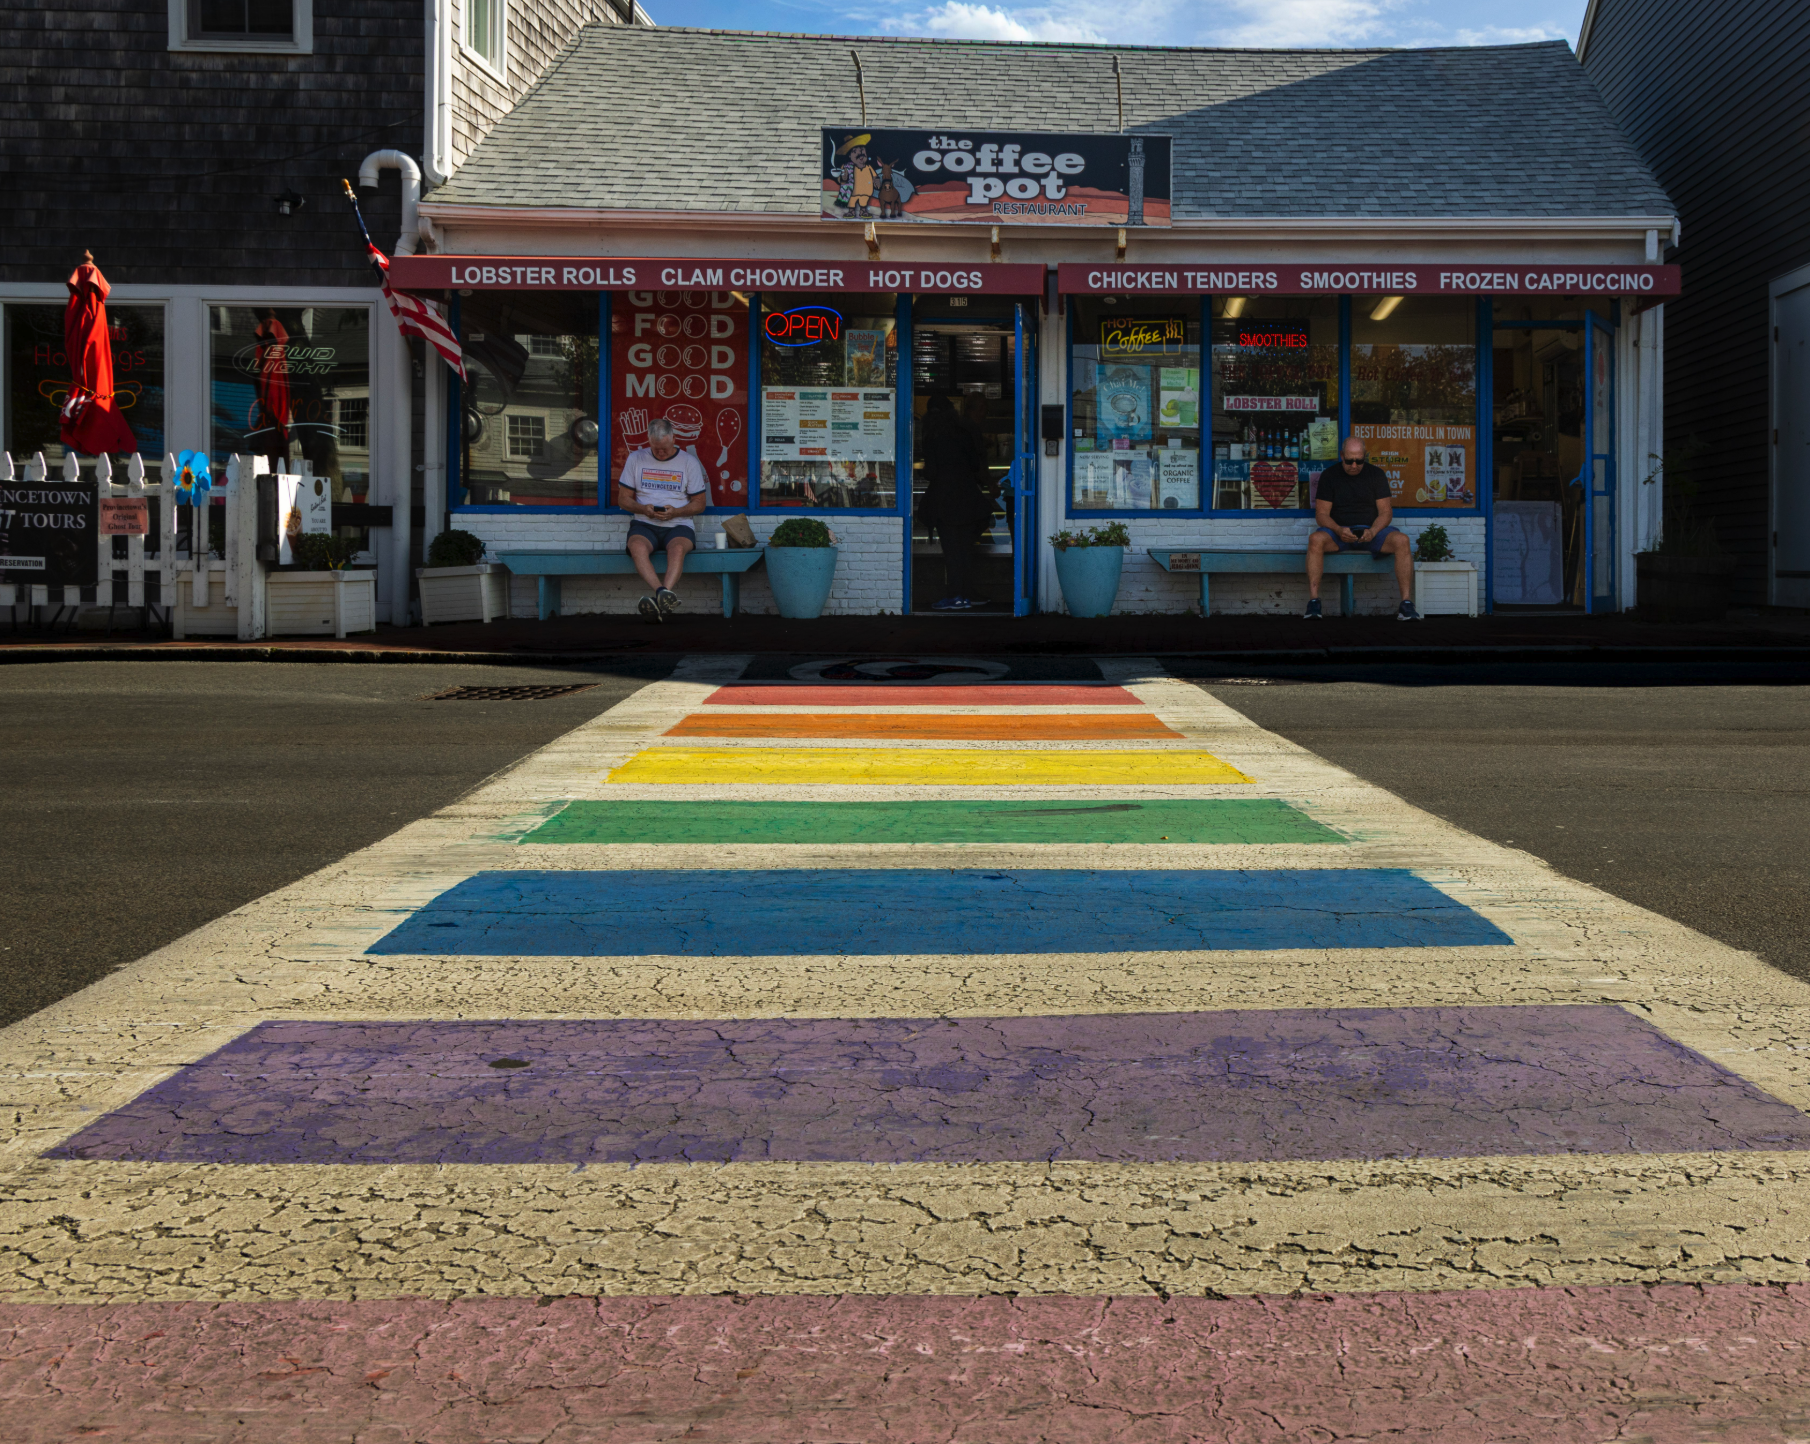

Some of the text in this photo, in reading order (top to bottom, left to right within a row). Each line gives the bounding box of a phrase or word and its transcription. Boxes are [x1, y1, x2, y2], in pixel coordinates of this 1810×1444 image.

[929, 135, 973, 150] the
[913, 143, 1085, 175] coffee
[966, 170, 1067, 204] pot
[993, 203, 1087, 217] RESTAURANT
[452, 266, 637, 285] LOBSTER ROLLS
[661, 268, 845, 287] CLAM CHOWDER
[870, 271, 984, 289] HOT DOGS
[1087, 271, 1278, 289] CHICKEN TENDERS
[1300, 272, 1417, 289] SMOOTHIES
[1439, 273, 1654, 291] FROZEN CAPPUCCINO
[628, 290, 736, 309] GOOD
[951, 298, 967, 306] 315
[634, 313, 735, 338] FOOD
[765, 312, 839, 340] OPEN
[1107, 318, 1134, 328] HOT
[848, 333, 874, 341] Bubble
[1106, 326, 1162, 353] Coffee
[1239, 333, 1307, 347] SMOOTHIES
[264, 344, 336, 360] BUD
[627, 343, 736, 369] GOOD
[246, 359, 339, 374] LIGHT
[625, 373, 735, 399] MOOD
[1225, 397, 1317, 410] LOBSTER ROLL
[1354, 425, 1471, 440] BEST LOBSTER ROLL IN TOWN
[103, 503, 147, 511] Provincetown's
[20, 512, 87, 530] TOURS
[113, 513, 138, 521] Original
